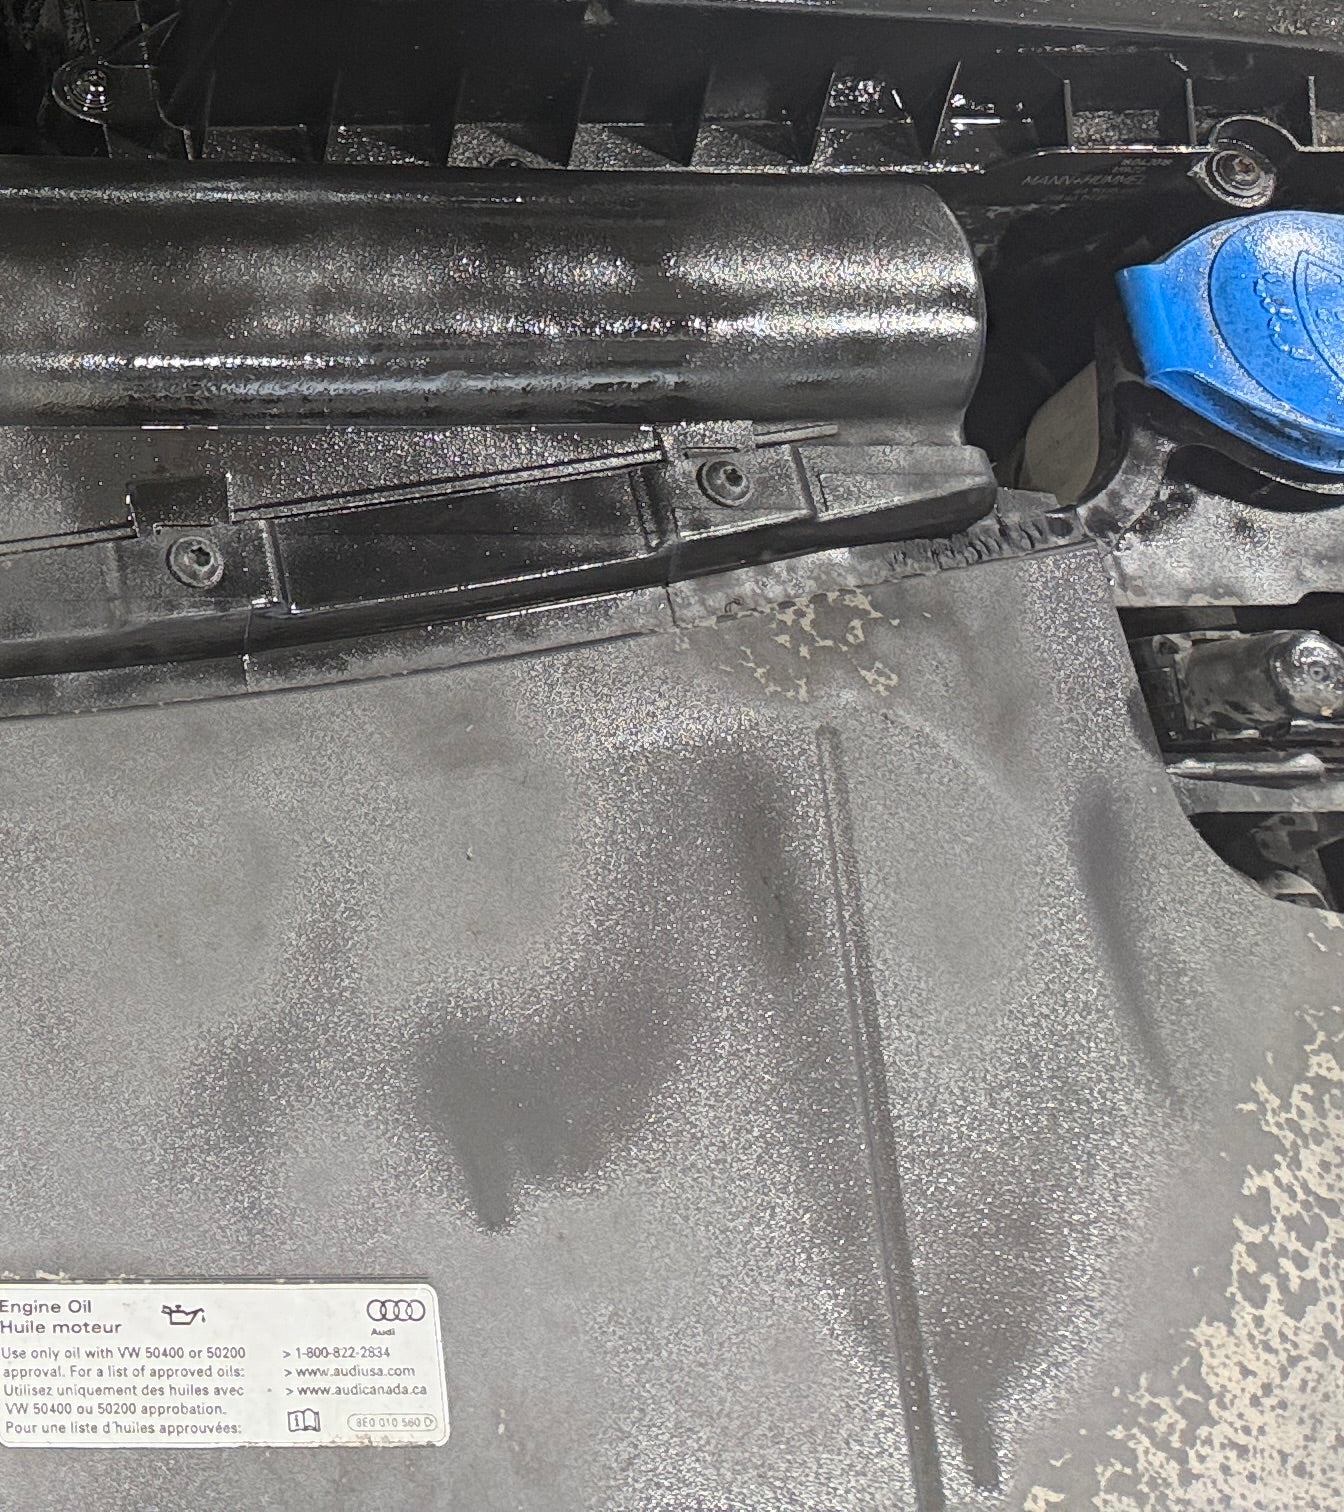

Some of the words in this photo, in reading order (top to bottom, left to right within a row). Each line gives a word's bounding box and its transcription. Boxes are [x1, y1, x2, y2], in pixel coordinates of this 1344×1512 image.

[0, 1300, 61, 1315] Engine
[68, 1299, 91, 1313] Oil
[0, 1320, 46, 1333] Huile
[53, 1322, 122, 1333] moteur
[371, 1328, 395, 1336] Audi
[2, 1347, 26, 1359] Use
[31, 1347, 59, 1361] only
[64, 1346, 80, 1358] oil
[85, 1347, 113, 1358] with
[118, 1347, 141, 1358] VW
[146, 1347, 184, 1358] 50400
[189, 1348, 202, 1358] or
[207, 1347, 245, 1358] 50200
[296, 1347, 390, 1358] 1-800-822-2834
[3, 1366, 65, 1380] approval.
[70, 1366, 91, 1377] For
[97, 1368, 103, 1377] a
[108, 1365, 127, 1377] list
[132, 1365, 145, 1377] of
[150, 1366, 212, 1379] approved
[217, 1365, 245, 1376] oils:
[295, 1365, 415, 1377] www.audiusa.com
[4, 1384, 52, 1396] Utilisez
[57, 1384, 136, 1399] uniquement
[141, 1384, 164, 1396] des
[169, 1384, 209, 1396] huiles
[214, 1386, 244, 1395] avec
[297, 1383, 427, 1395] www.audicanada.ca
[6, 1403, 28, 1414] VW
[33, 1403, 71, 1414] 50400
[77, 1405, 93, 1415] ou
[98, 1403, 136, 1414] 50200
[141, 1403, 227, 1416] approbation.
[6, 1422, 36, 1434] Pour
[42, 1424, 65, 1433] une
[71, 1421, 97, 1433] liste
[159, 1421, 242, 1436] approuvées:
